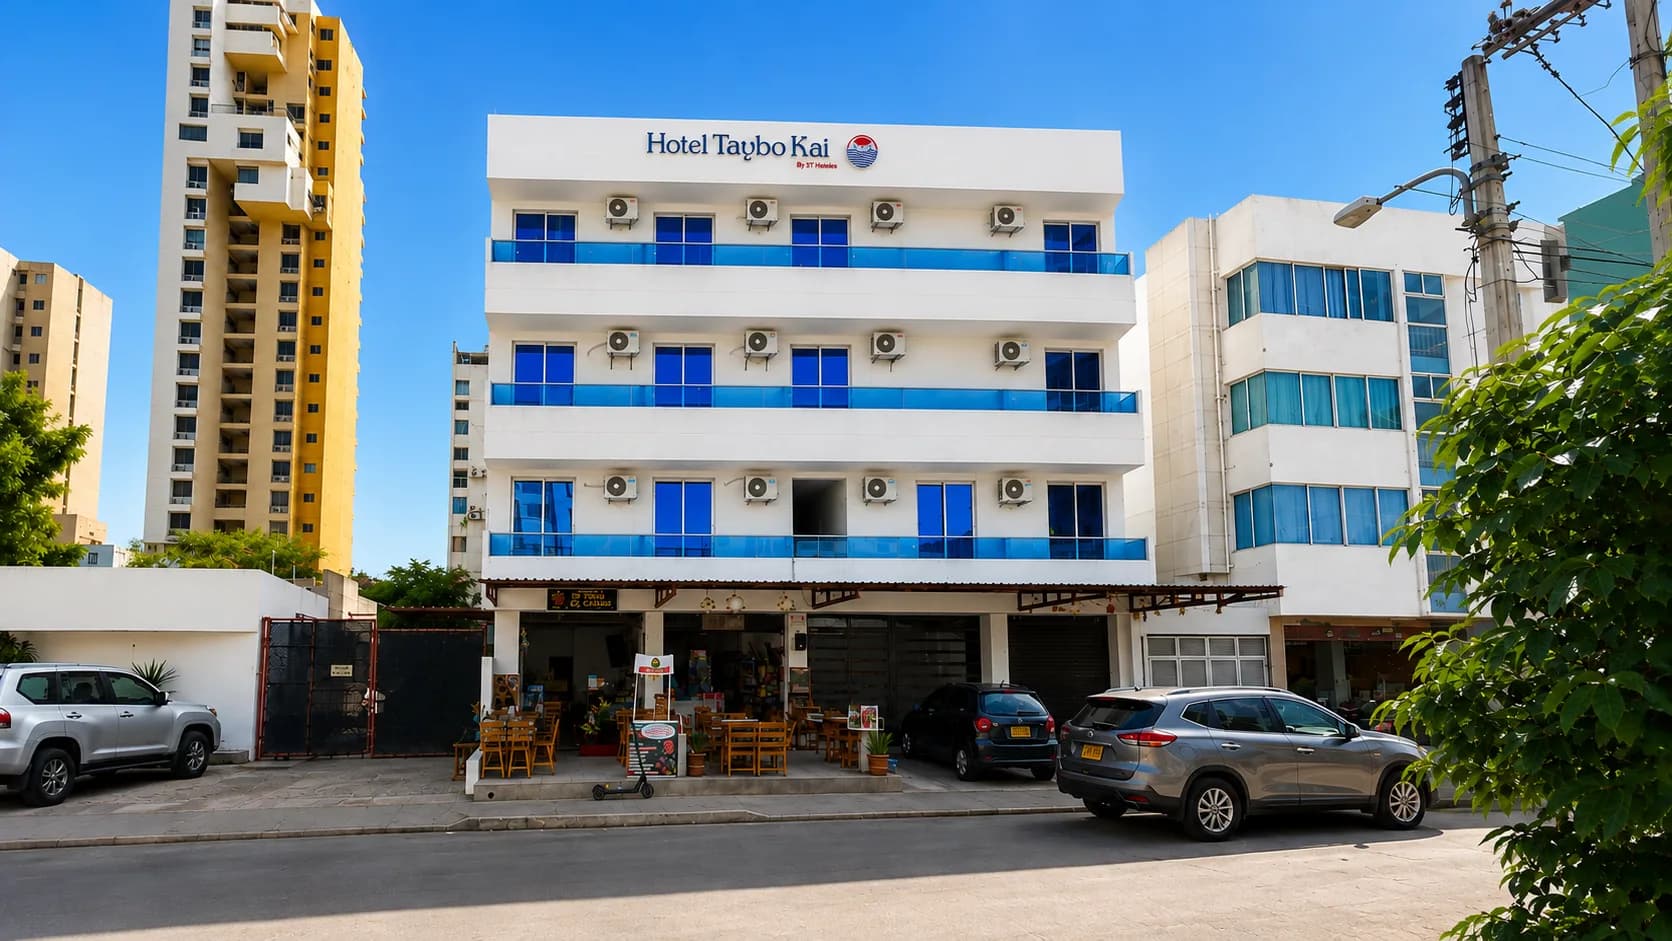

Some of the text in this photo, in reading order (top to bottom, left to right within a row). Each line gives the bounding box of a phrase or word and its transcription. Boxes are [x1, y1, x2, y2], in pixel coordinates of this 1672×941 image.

[647, 132, 830, 161] Hotel Taybo Kai
[796, 161, 805, 170] By
